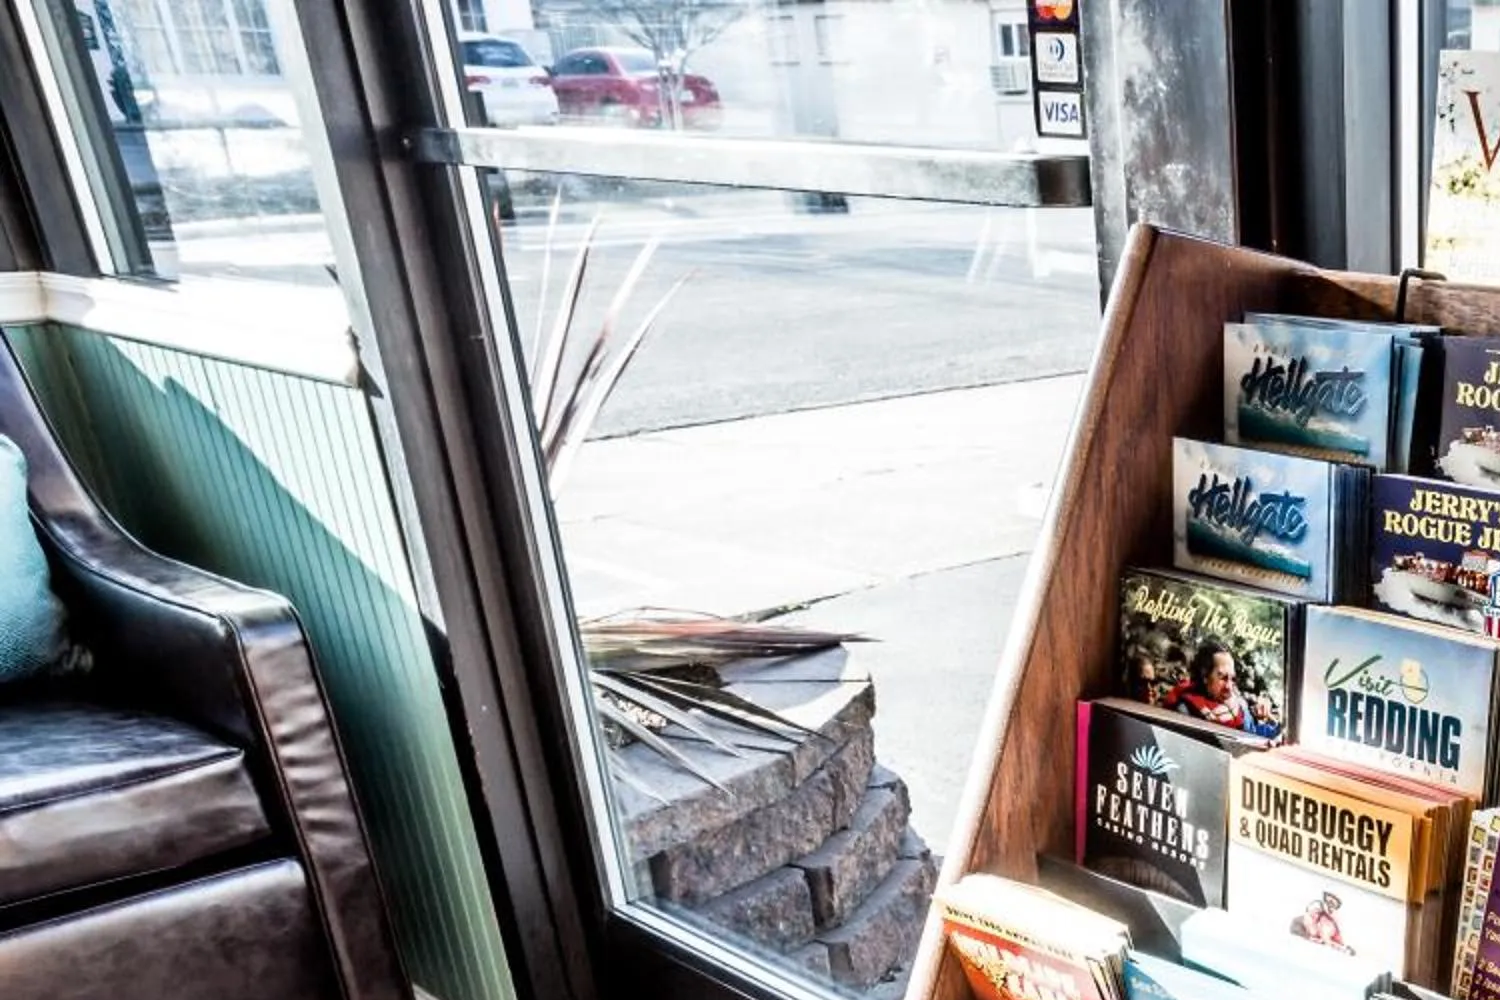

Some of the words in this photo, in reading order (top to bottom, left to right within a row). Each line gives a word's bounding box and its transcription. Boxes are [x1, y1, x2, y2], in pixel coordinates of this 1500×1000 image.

[1044, 102, 1078, 122] VISA
[1240, 356, 1368, 429] Hellgate
[1188, 473, 1308, 546] Hellgate
[1383, 509, 1472, 546] ROGUE
[1133, 586, 1197, 633] Rafting
[1191, 592, 1228, 634] The
[1232, 609, 1281, 650] Rogue
[1327, 688, 1462, 771] REDDING
[1095, 784, 1210, 859] FEATHERS
[1116, 762, 1189, 818] SEVEN
[1240, 775, 1393, 857] DUNEBUGGY
[1238, 817, 1251, 838] &
[1255, 819, 1303, 858] QUAD
[1308, 838, 1391, 888] RENTALS
